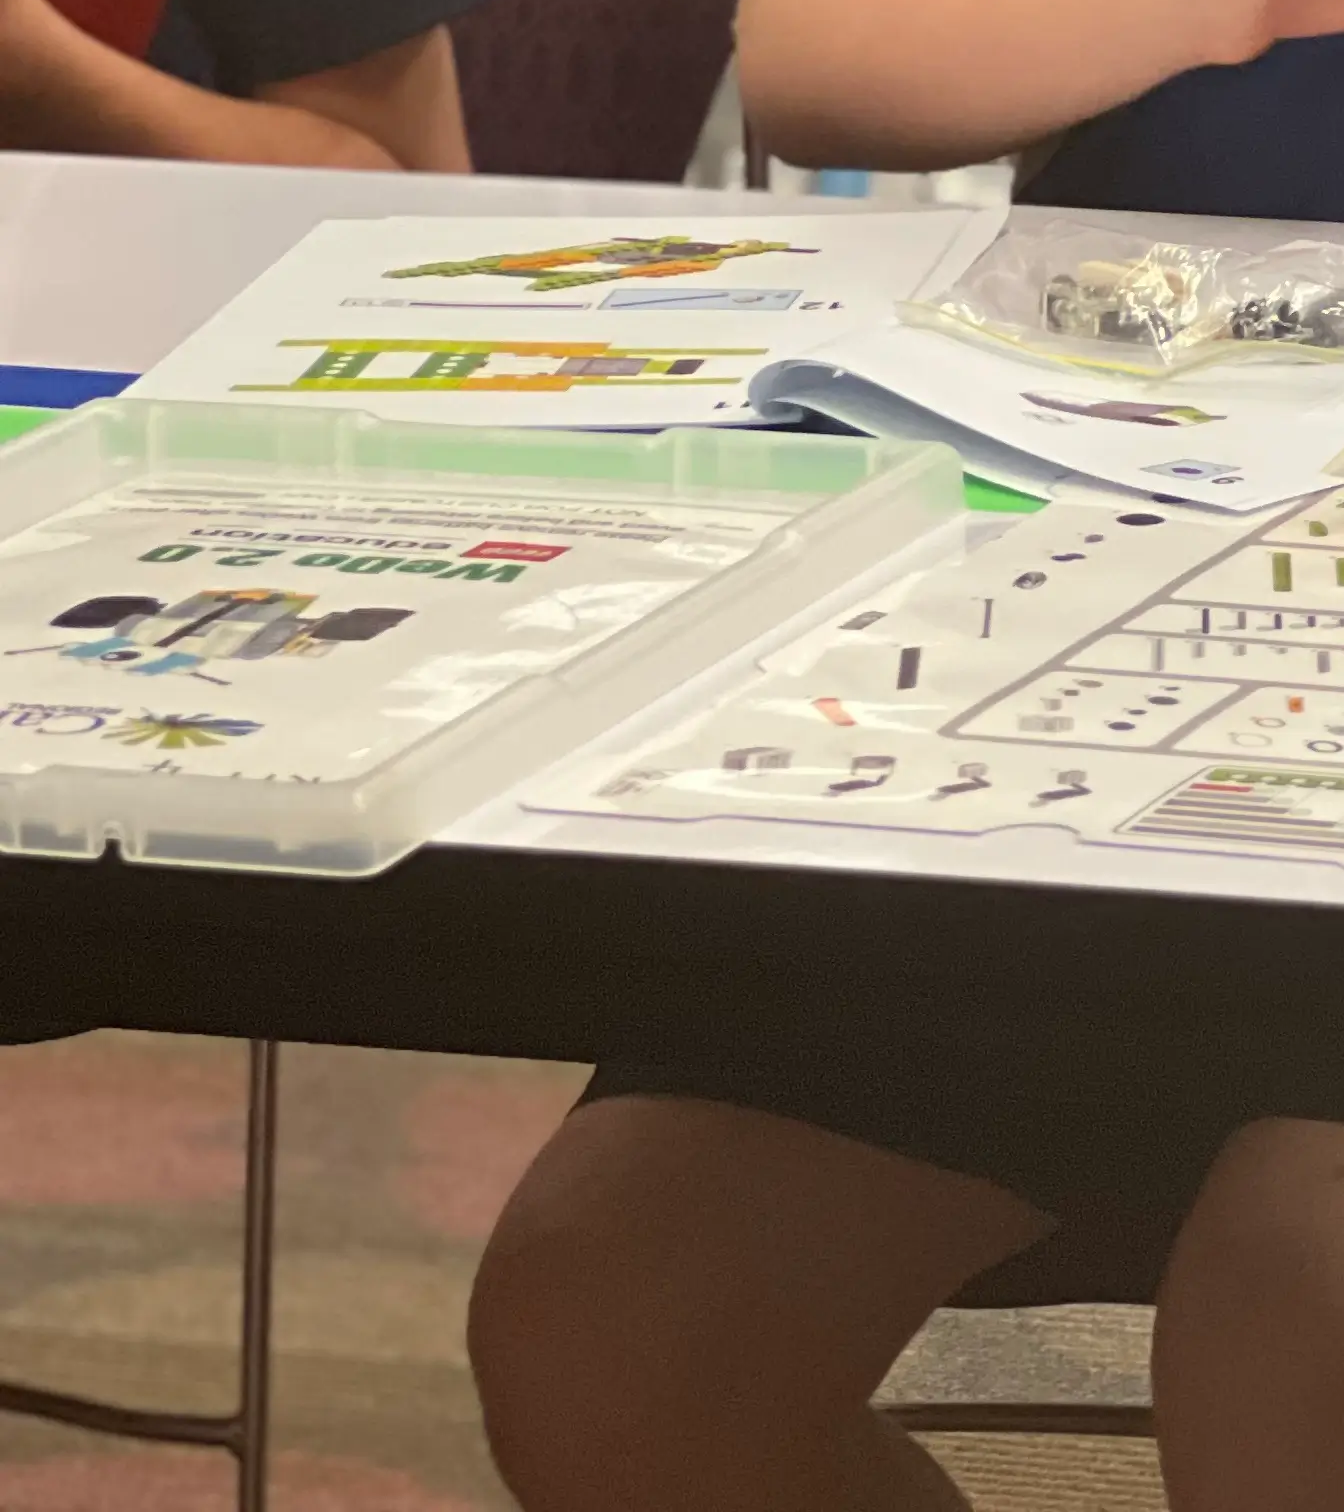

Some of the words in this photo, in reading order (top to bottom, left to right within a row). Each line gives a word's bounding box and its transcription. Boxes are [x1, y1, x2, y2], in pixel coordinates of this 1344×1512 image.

[189, 528, 452, 550] education
[137, 543, 286, 567] 2.0
[292, 552, 528, 583] WeDo
